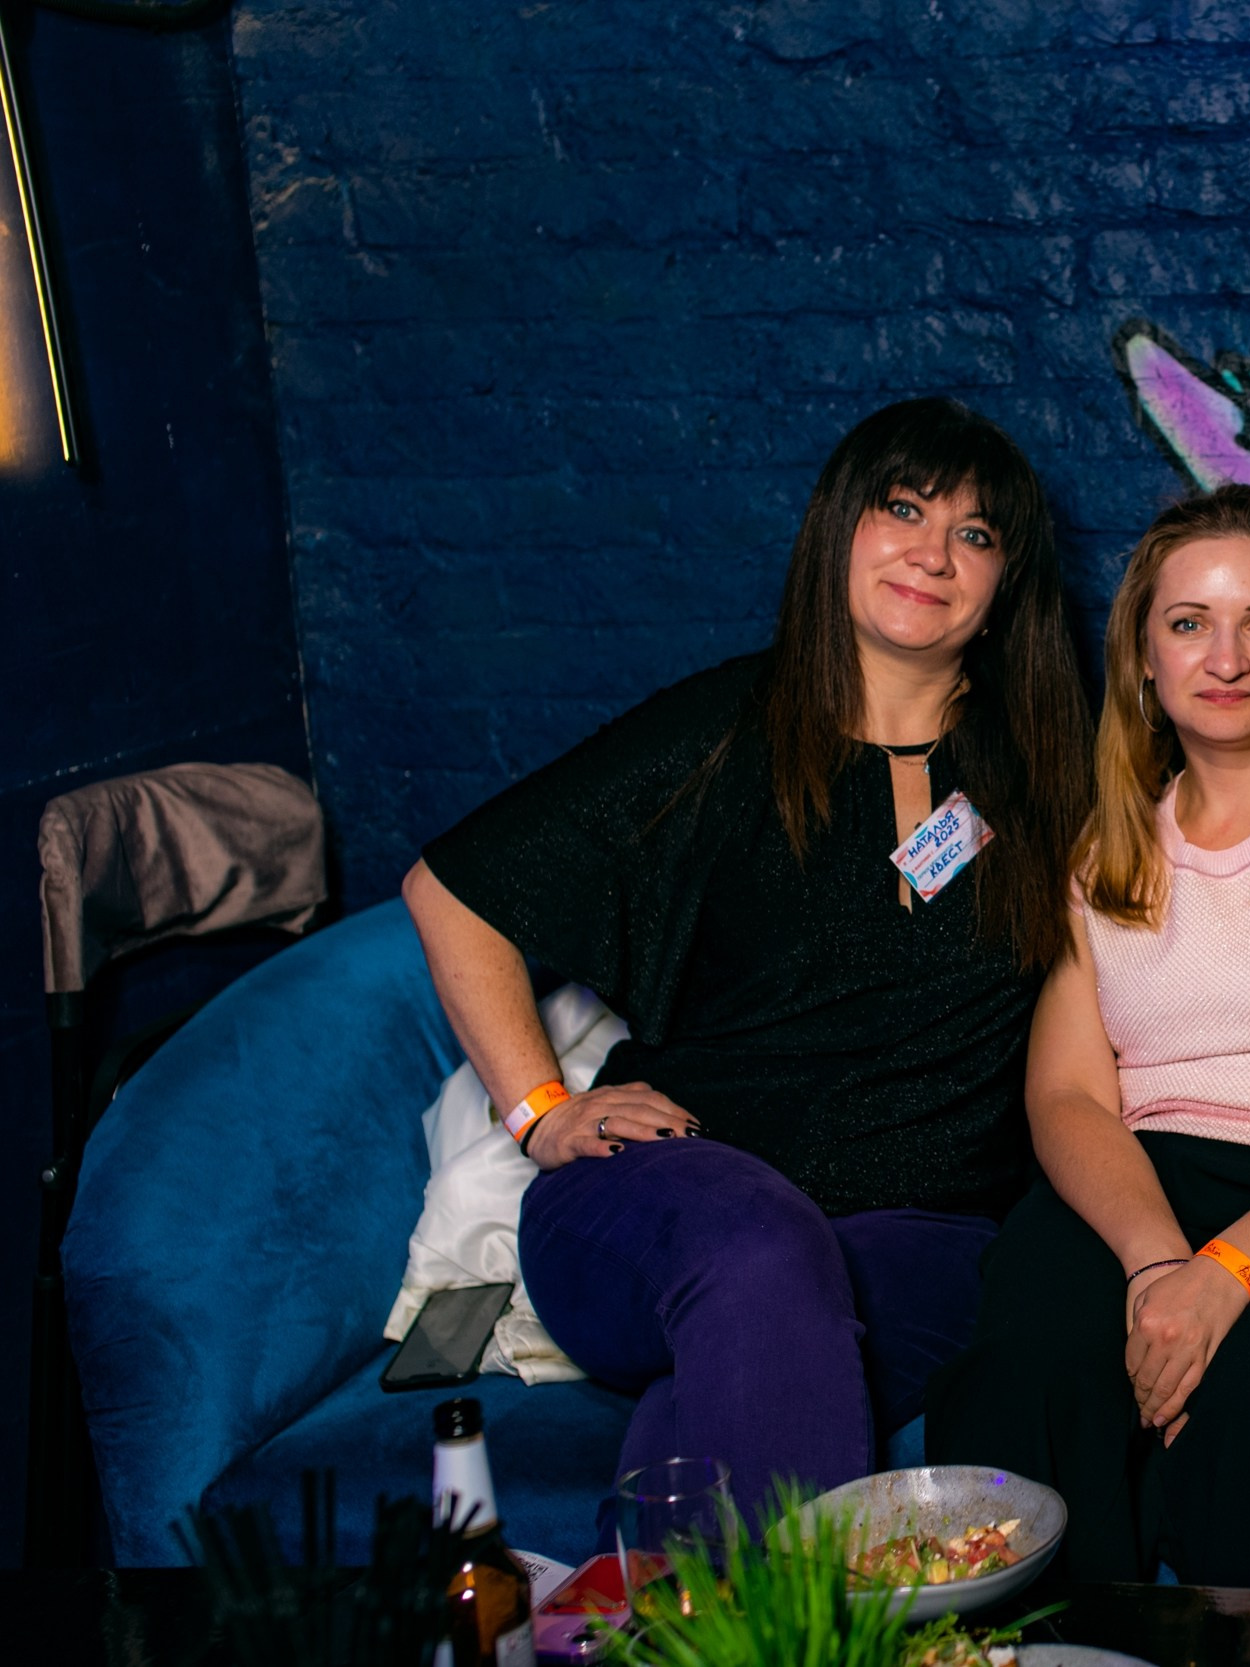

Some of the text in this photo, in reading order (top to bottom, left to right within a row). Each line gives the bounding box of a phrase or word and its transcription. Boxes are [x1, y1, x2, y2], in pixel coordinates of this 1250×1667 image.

[908, 809, 955, 858] НАТАЛЬЯ
[933, 817, 960, 849] 2025
[929, 840, 964, 878] КВЕСТ
